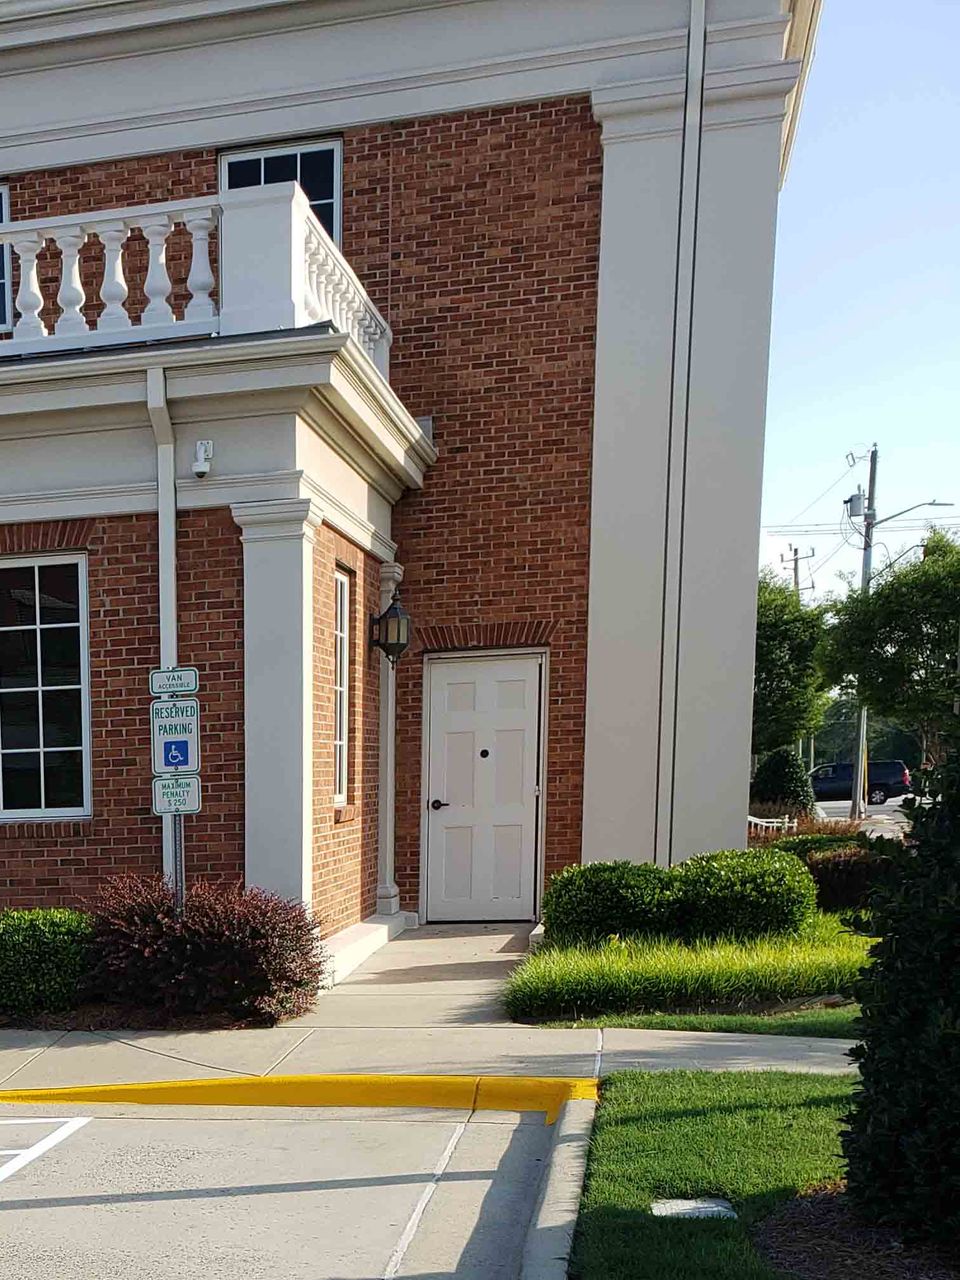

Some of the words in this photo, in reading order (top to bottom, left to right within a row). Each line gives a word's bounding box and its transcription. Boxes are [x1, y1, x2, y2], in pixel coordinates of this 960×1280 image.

[166, 674, 182, 682] VAN
[155, 705, 195, 719] RESERVED
[158, 723, 192, 736] PARKING
[161, 782, 191, 790] MAXIMUM
[162, 790, 189, 799] PENALTY
